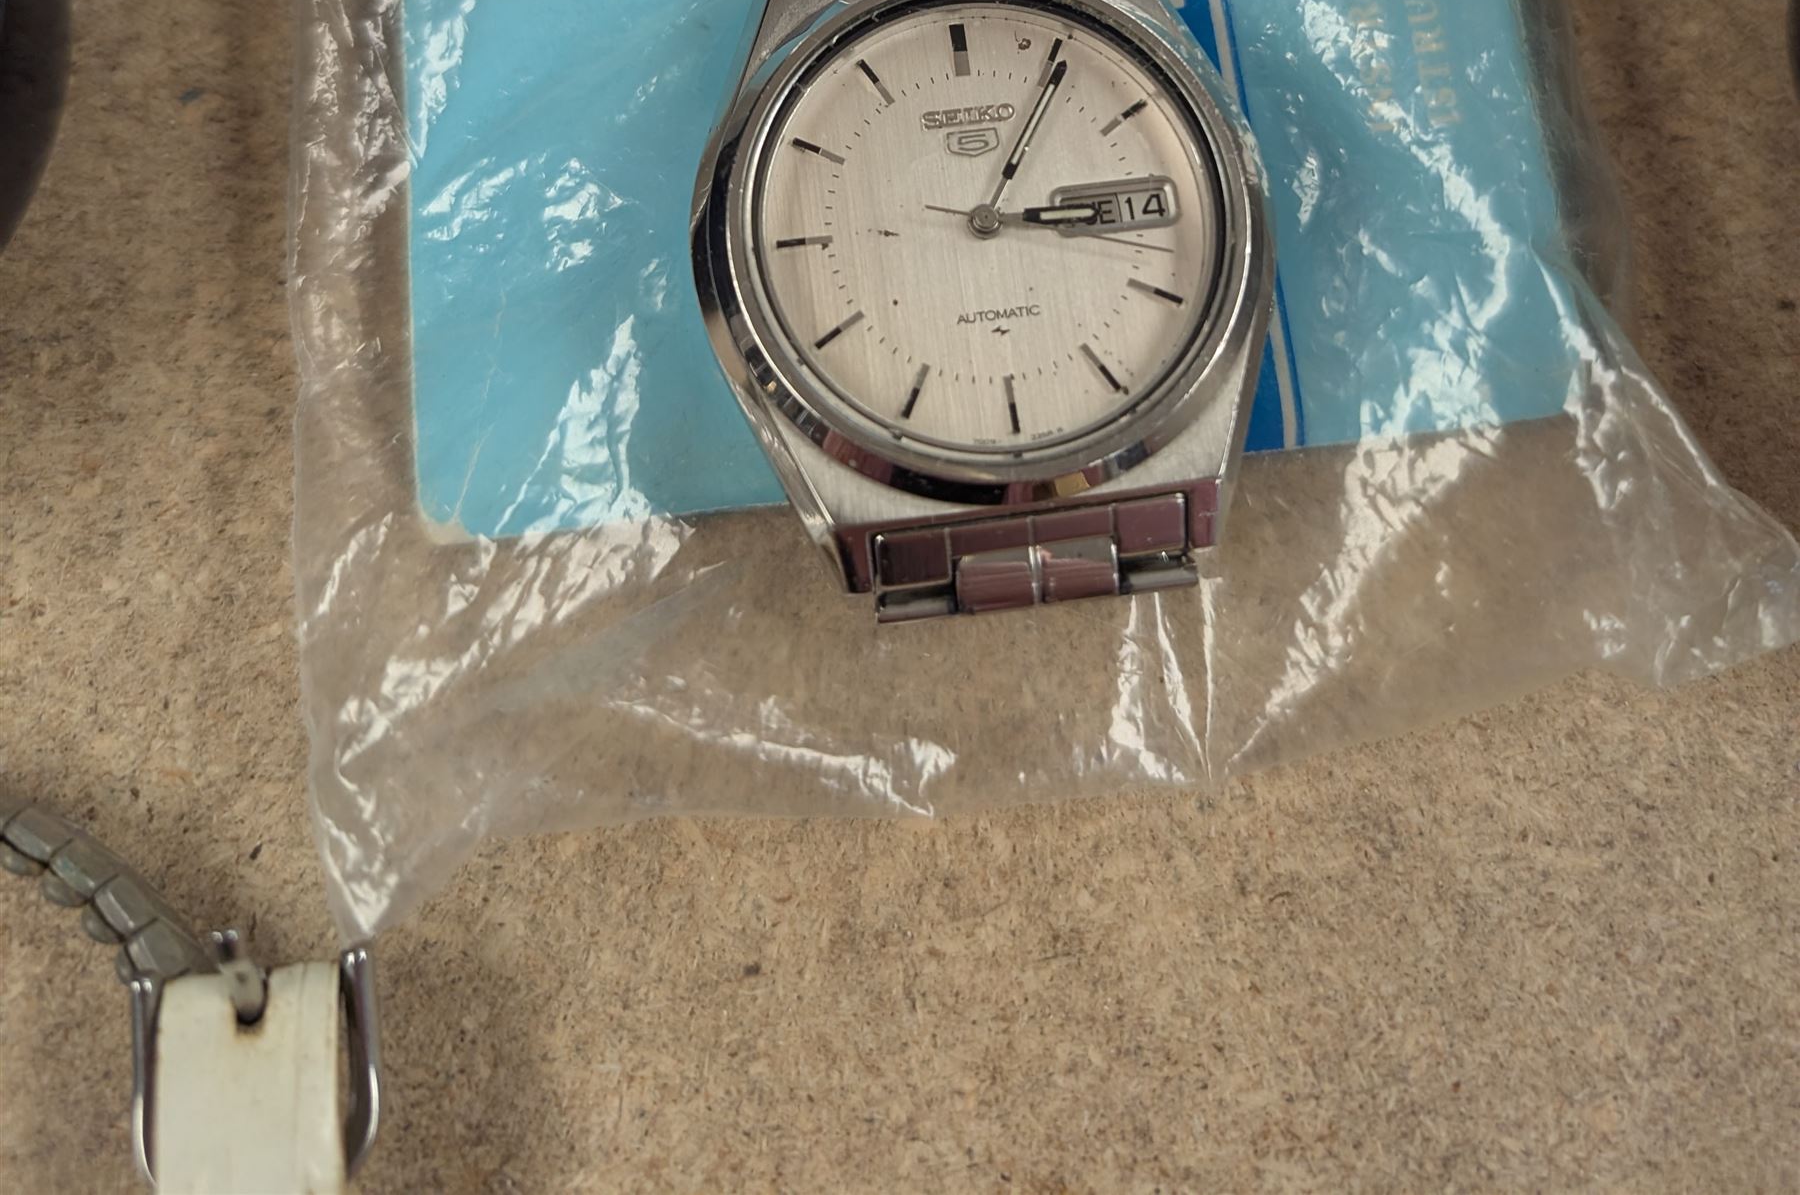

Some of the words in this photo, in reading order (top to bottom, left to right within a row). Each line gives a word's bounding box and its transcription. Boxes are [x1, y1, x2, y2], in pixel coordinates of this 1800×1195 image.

[921, 103, 1016, 131] SEIKO
[957, 134, 990, 151] 5
[1124, 193, 1166, 220] 14
[957, 305, 1041, 325] AUTOMATIC
